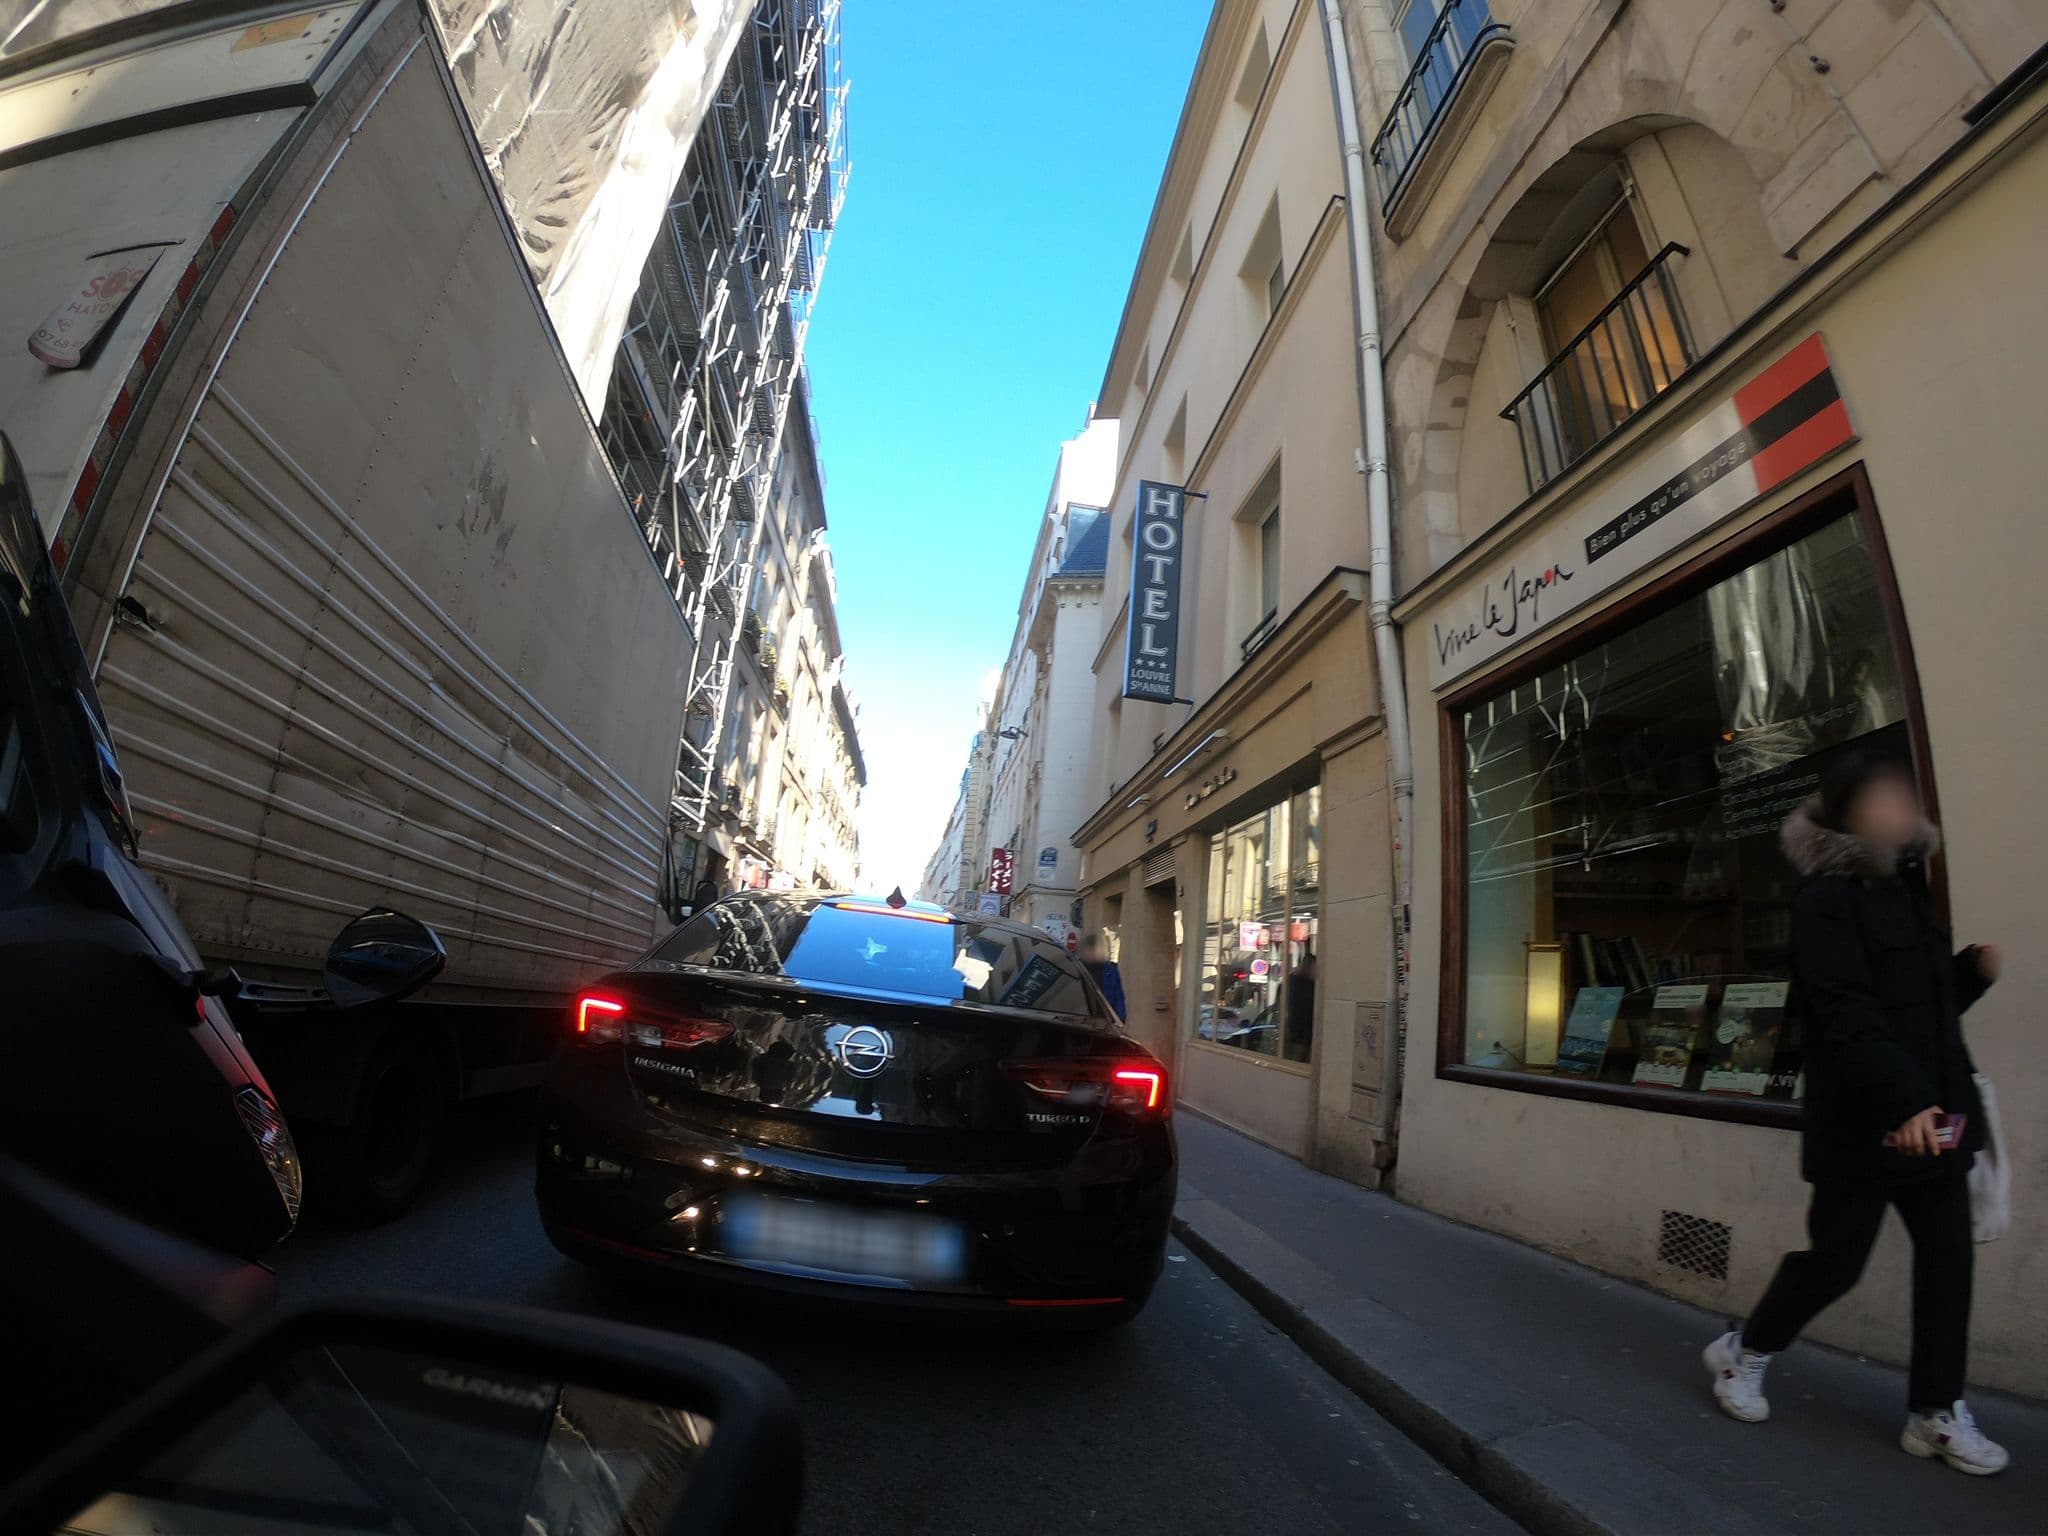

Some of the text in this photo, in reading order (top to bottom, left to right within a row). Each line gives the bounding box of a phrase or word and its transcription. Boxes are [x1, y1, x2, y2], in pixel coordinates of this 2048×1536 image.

[1590, 530, 1617, 553] Bien
[1620, 510, 1647, 538] plus
[1140, 488, 1180, 656] HOTEL
[1482, 583, 1503, 629] le
[1496, 564, 1574, 637] Japon
[1130, 668, 1172, 683] LOUVRE
[634, 1056, 696, 1079] INSIGNIA
[1026, 1113, 1077, 1124] TURBO
